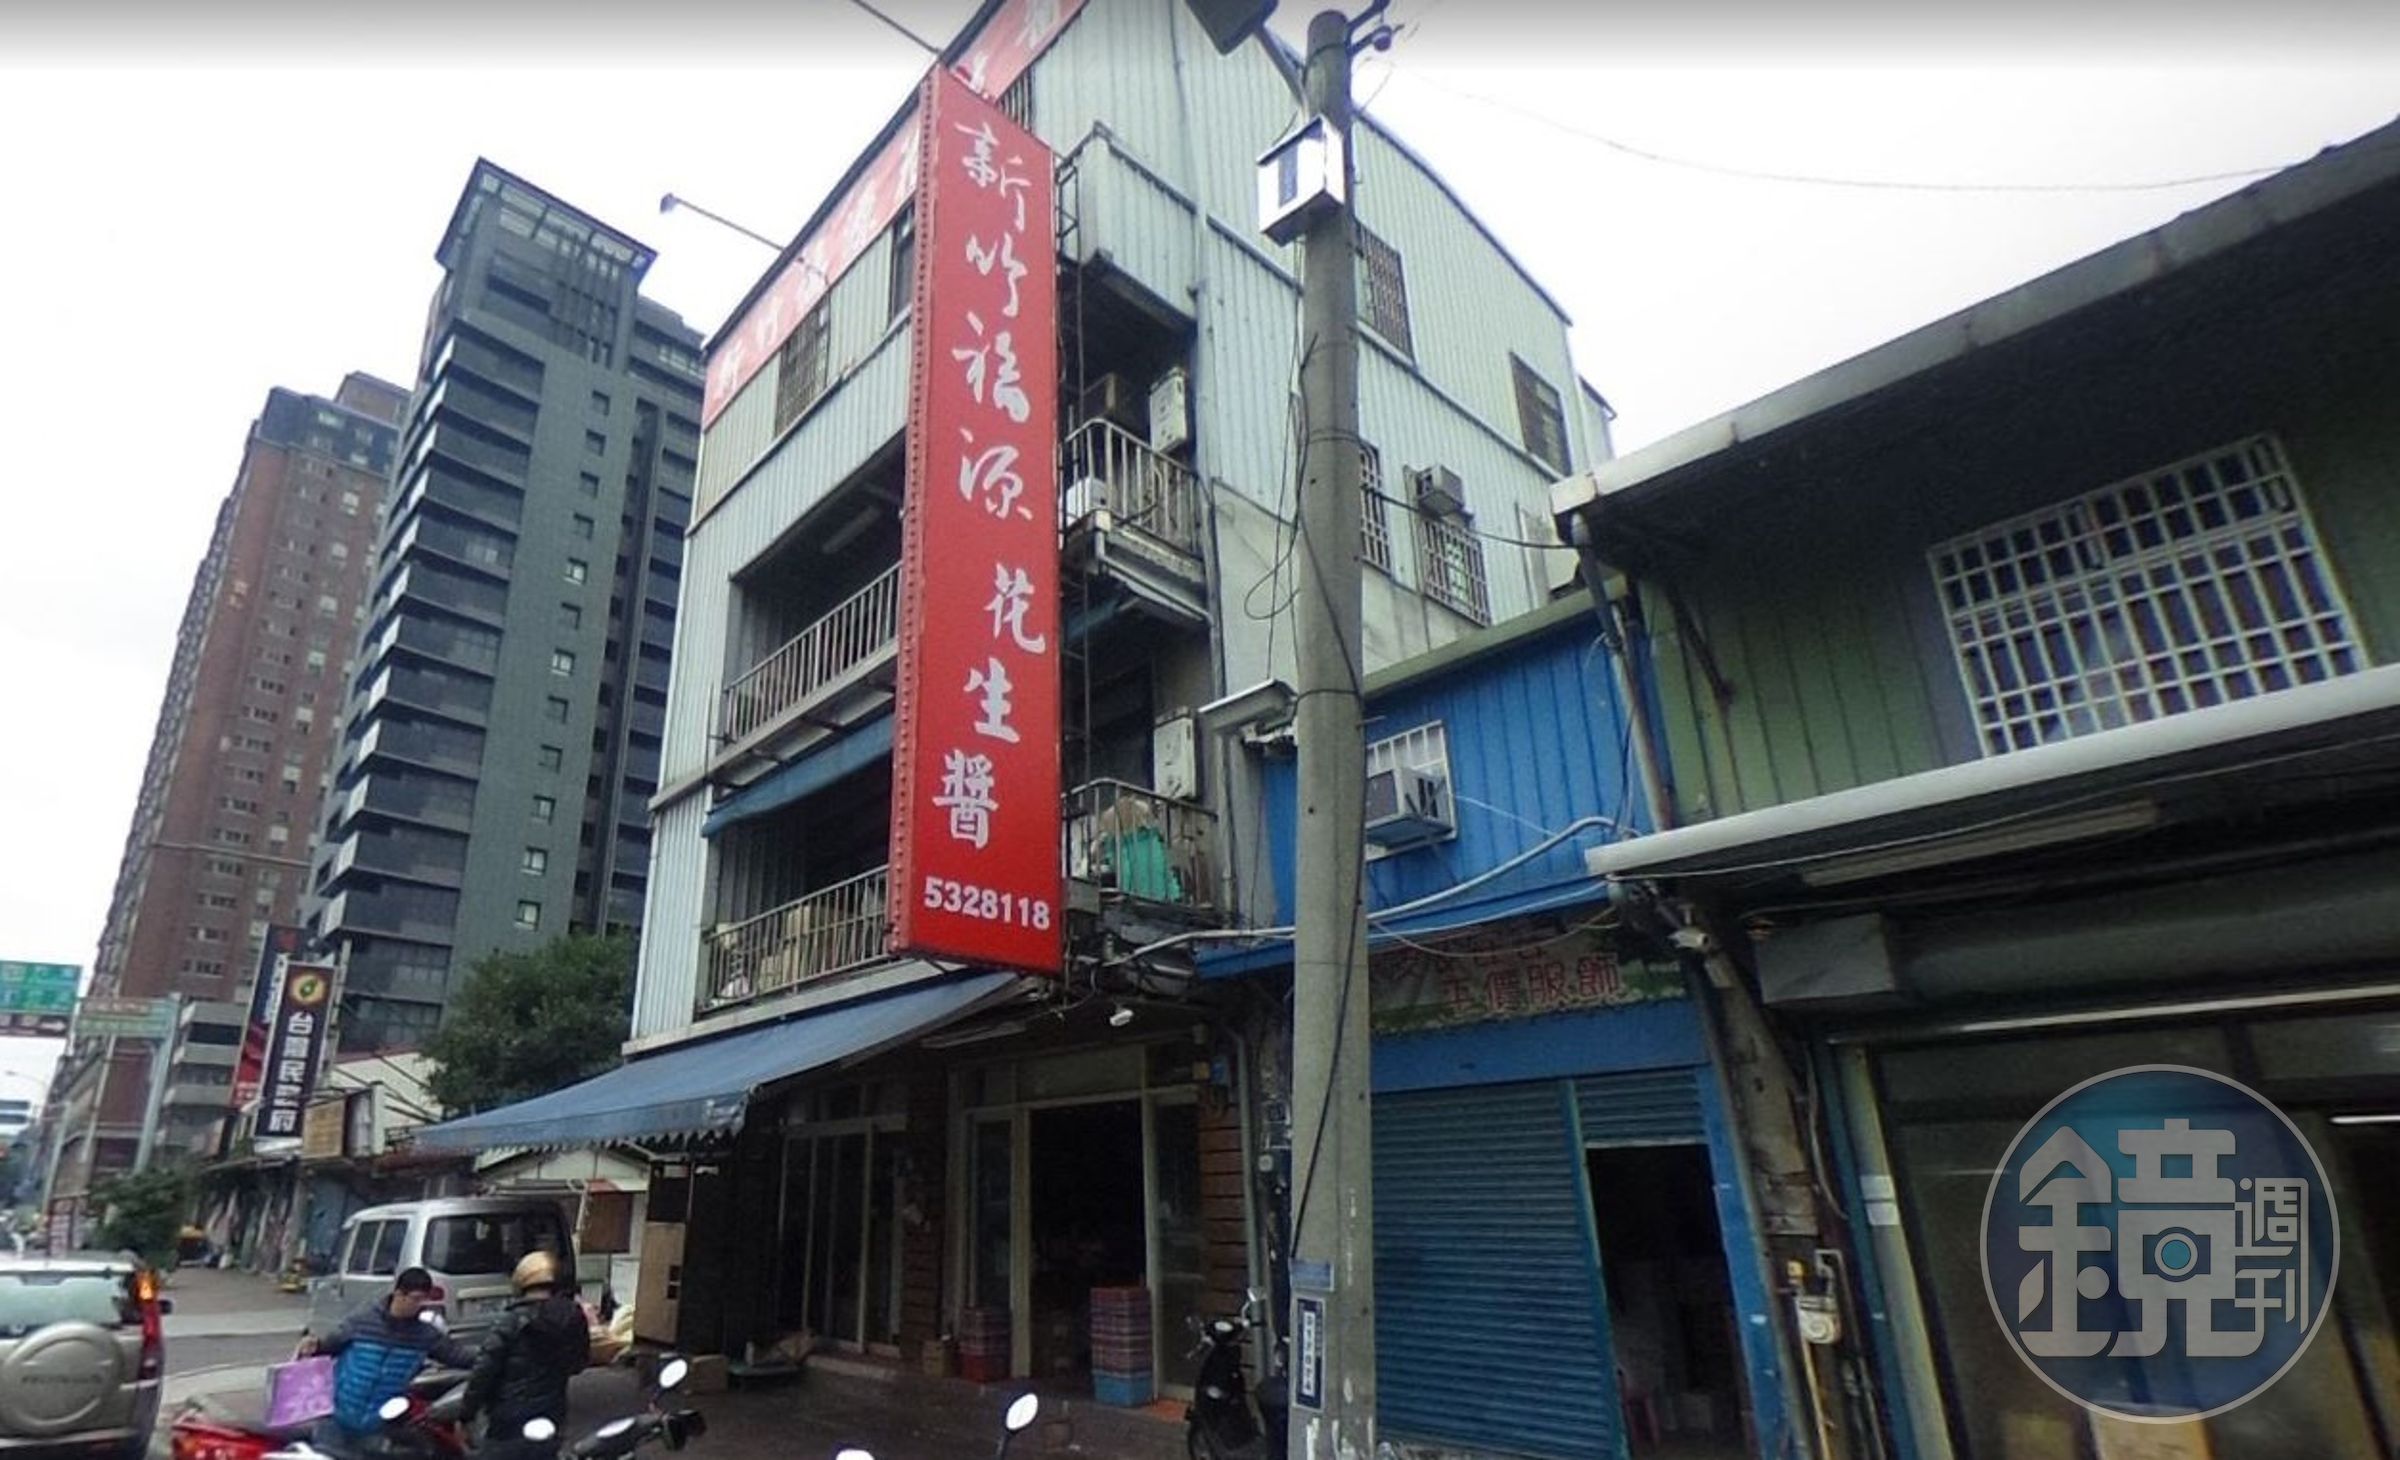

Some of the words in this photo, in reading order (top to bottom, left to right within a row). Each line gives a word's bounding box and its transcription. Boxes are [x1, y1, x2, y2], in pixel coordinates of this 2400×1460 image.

[931, 121, 1046, 850] 新竹福源花生醬
[923, 875, 1051, 930] 5328118
